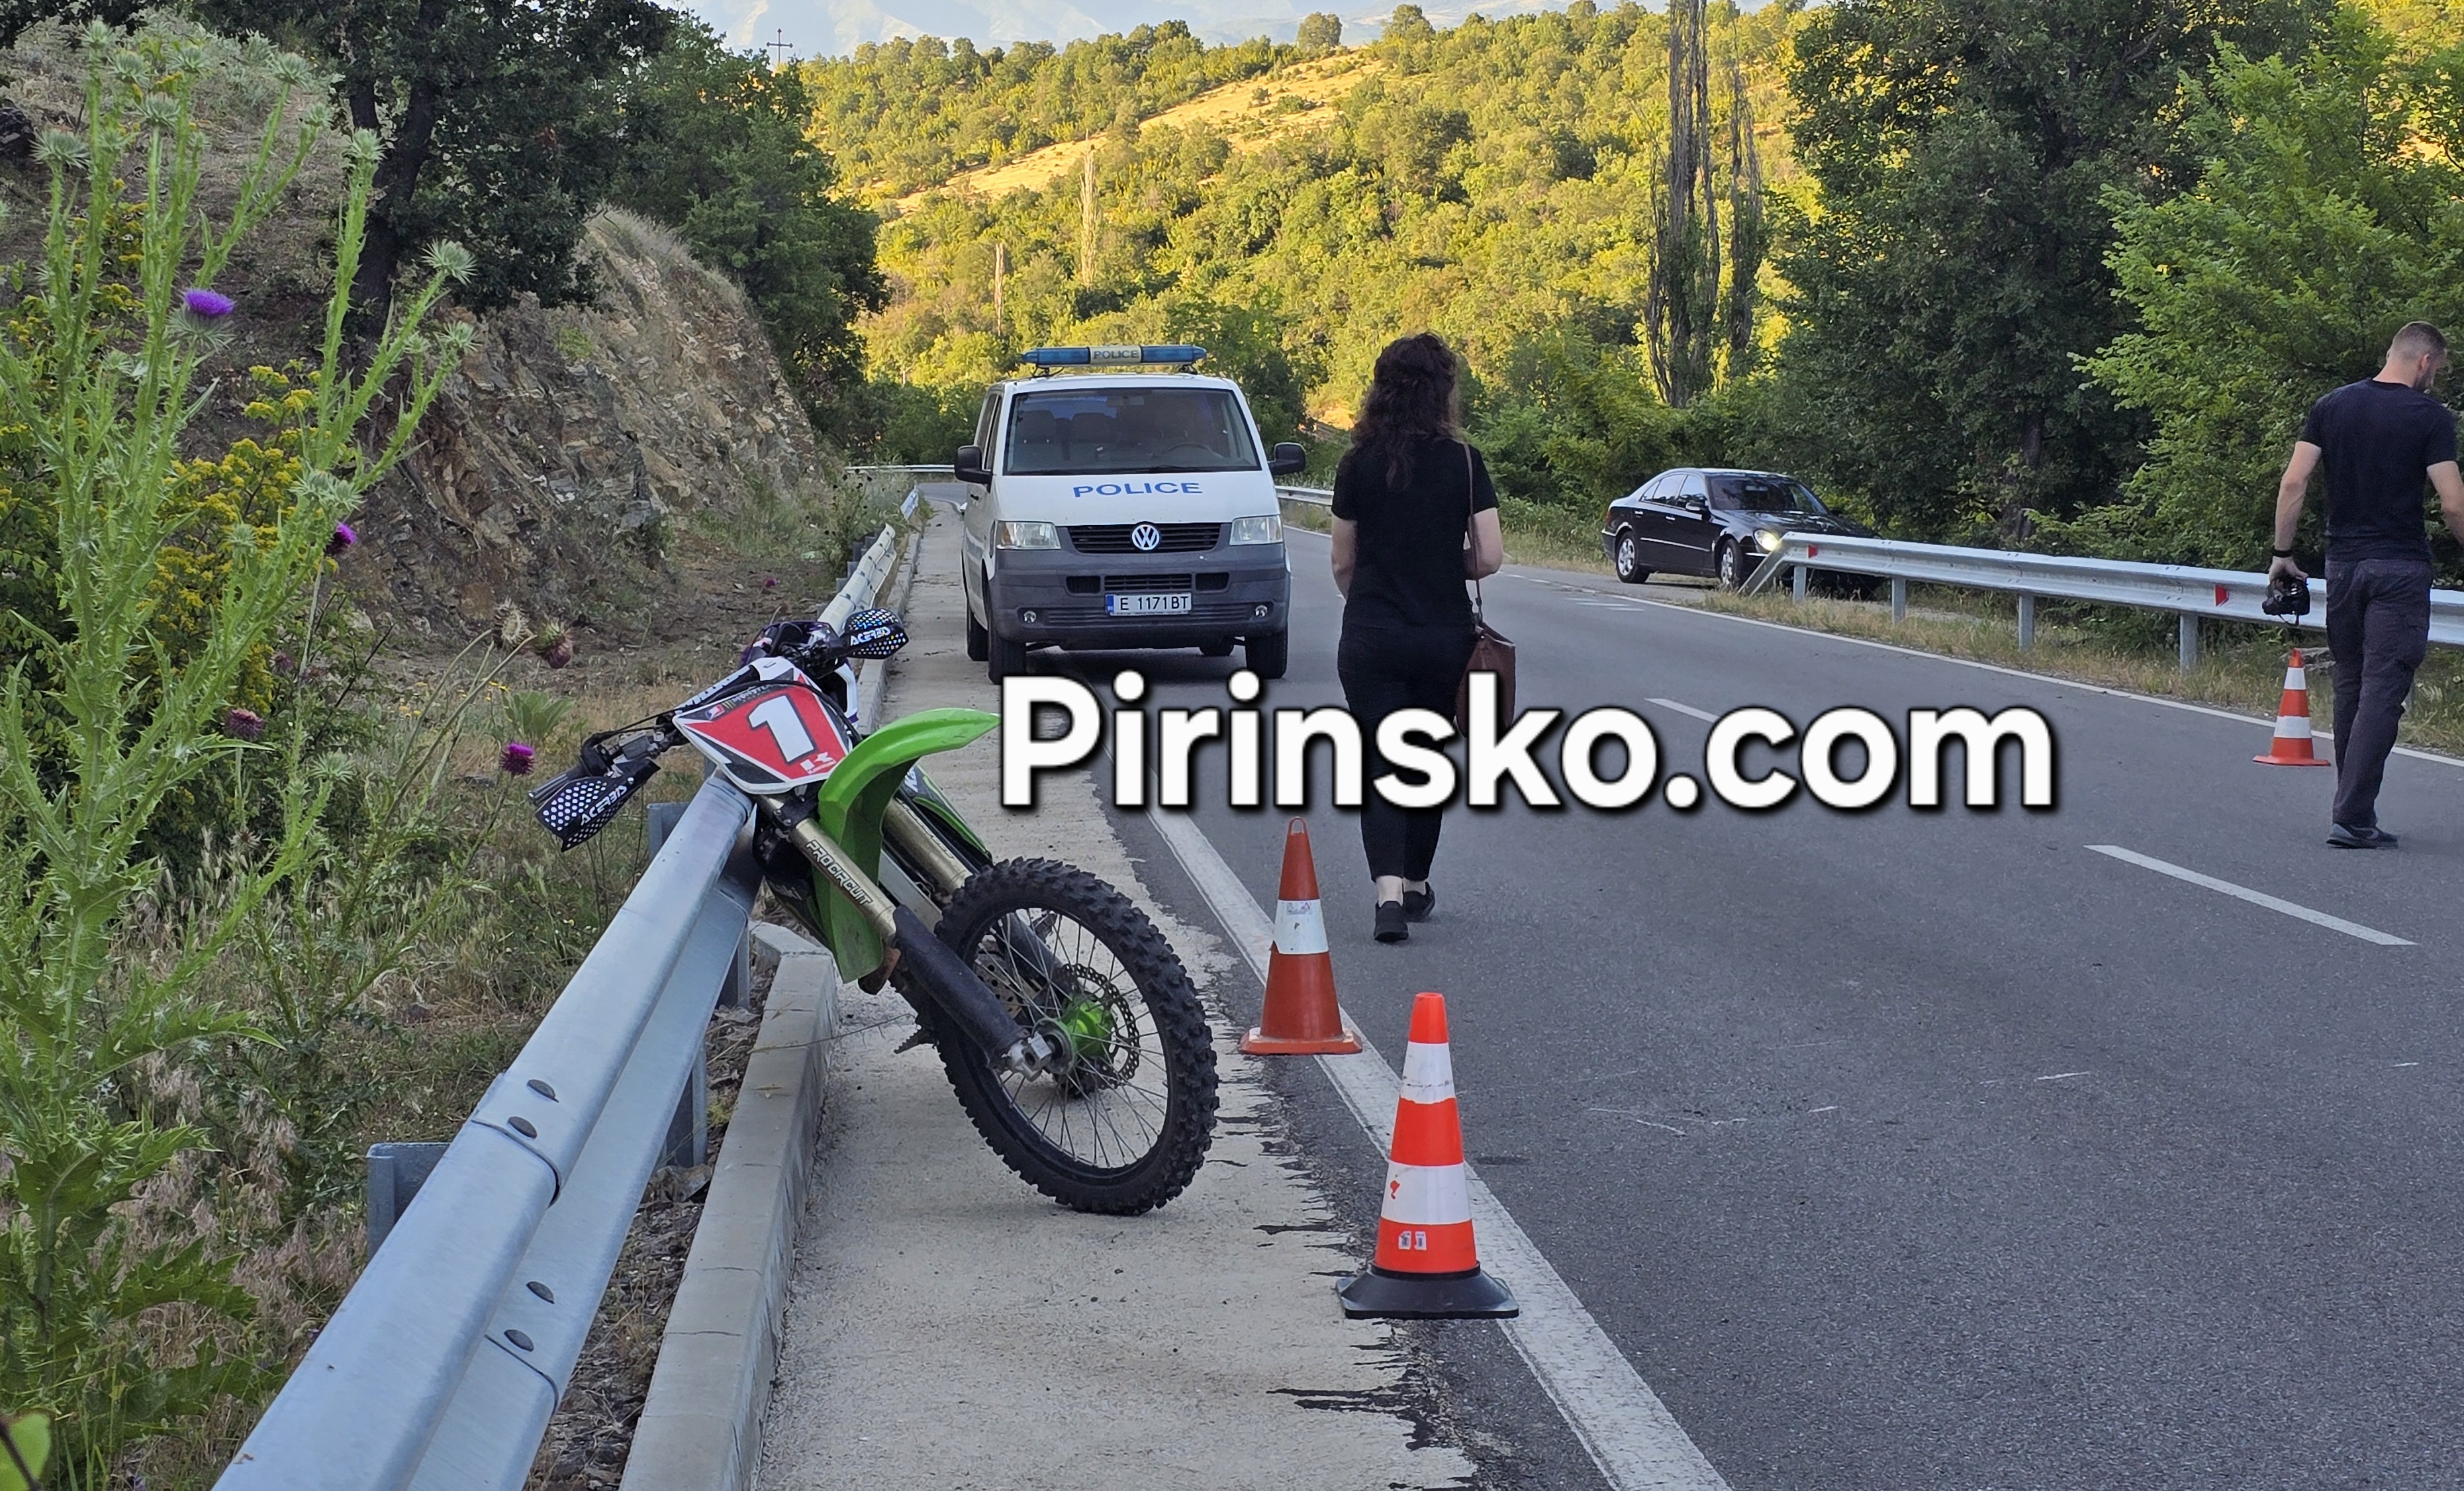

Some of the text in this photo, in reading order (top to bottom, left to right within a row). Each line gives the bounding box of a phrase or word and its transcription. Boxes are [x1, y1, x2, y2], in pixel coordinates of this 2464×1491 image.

[1093, 350, 1139, 360] POLICE
[1072, 482, 1203, 498] POLICE
[1119, 597, 1129, 610] E
[748, 695, 814, 763] 1
